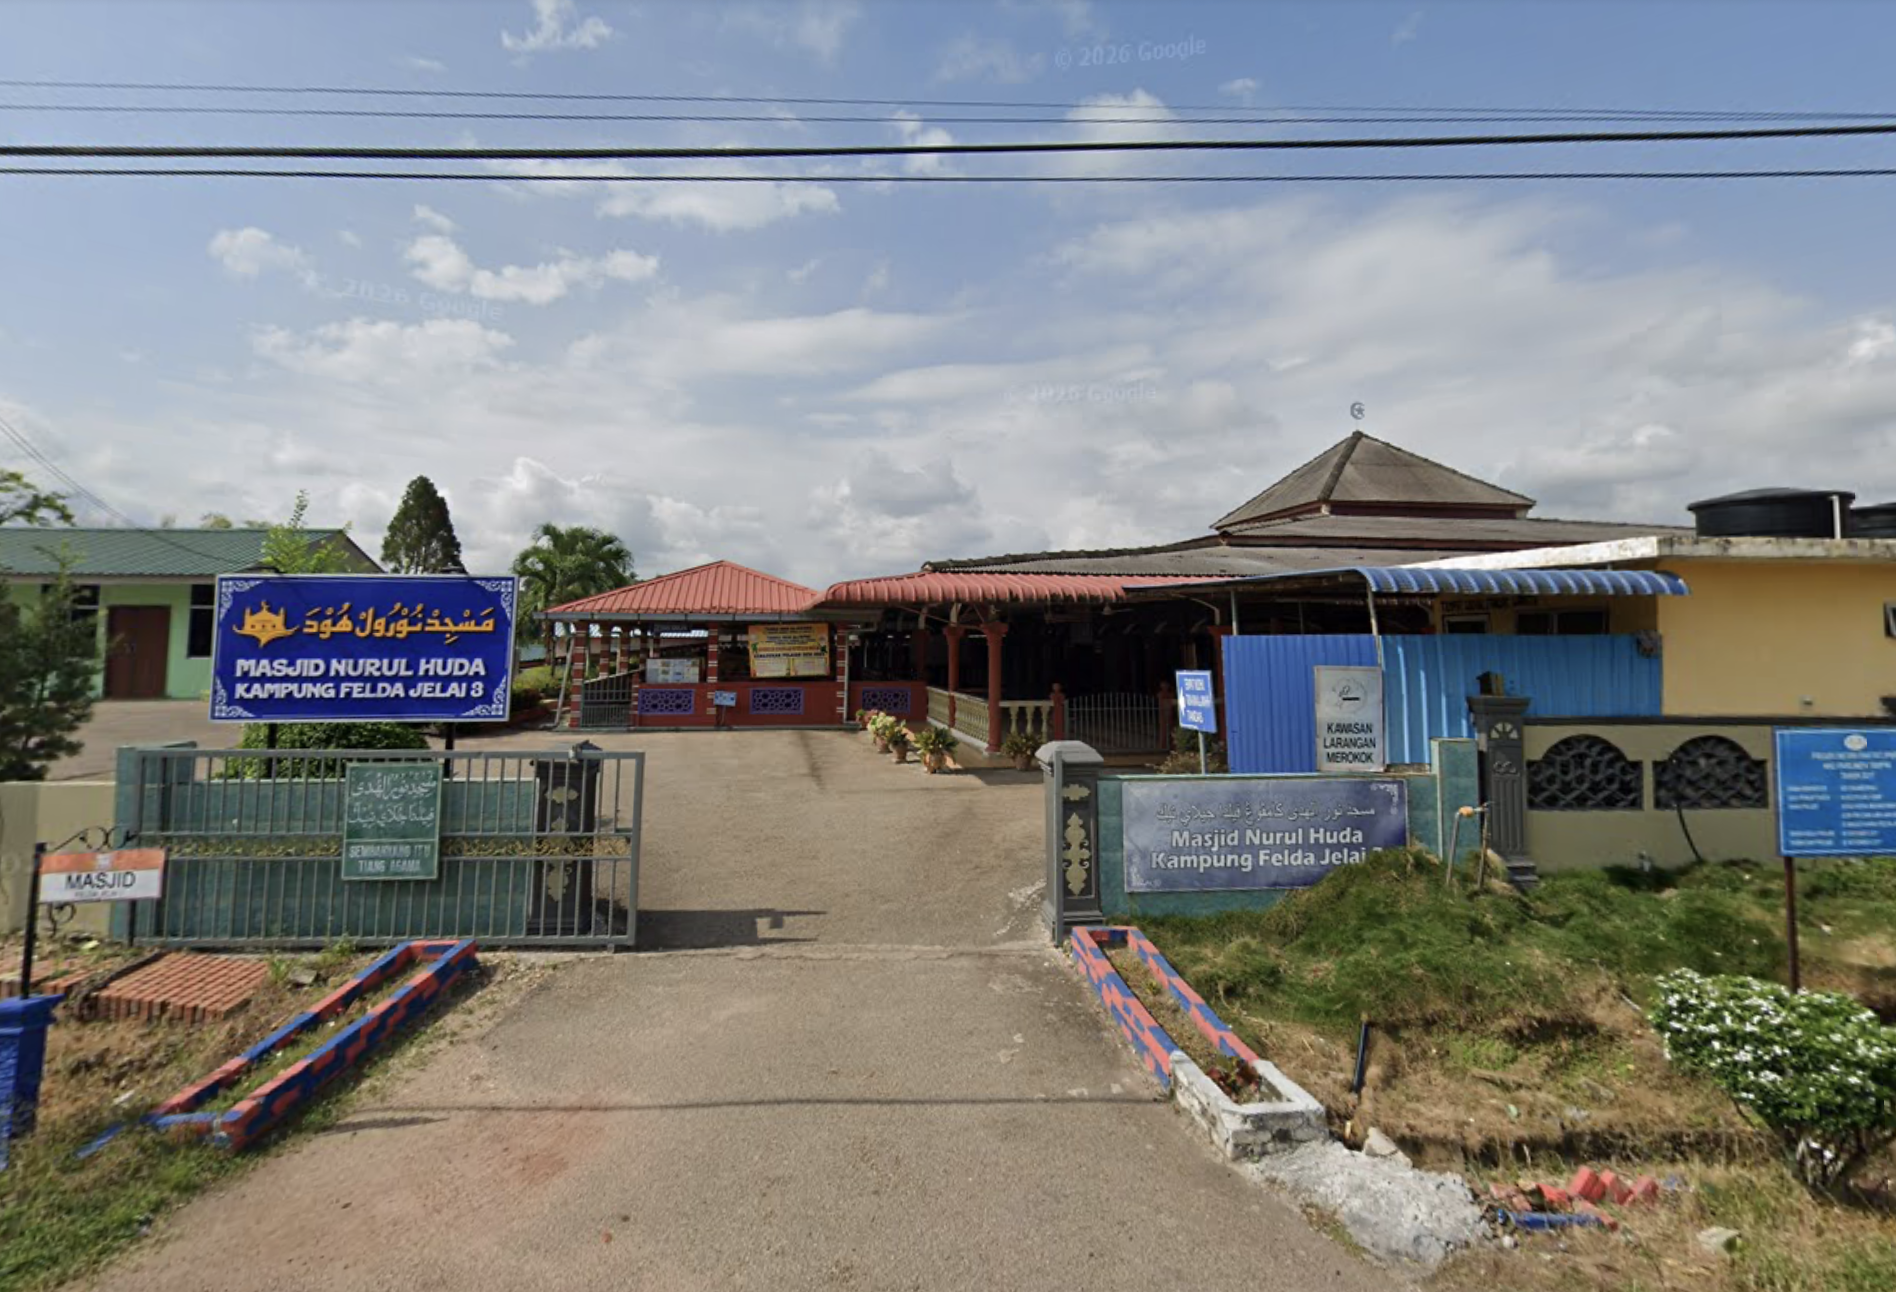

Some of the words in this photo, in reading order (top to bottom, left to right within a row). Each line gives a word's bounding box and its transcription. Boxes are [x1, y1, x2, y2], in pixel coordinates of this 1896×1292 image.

[236, 658, 326, 678] MASJID
[329, 658, 414, 677] NURUL
[418, 657, 486, 676] HUDA
[234, 682, 336, 699] KAMPUNG
[339, 682, 405, 698] FELDA
[408, 681, 467, 698] JELAI
[470, 681, 484, 698] 3
[1326, 722, 1374, 734] KAWASAN
[1323, 737, 1377, 749] LARANGAN
[1326, 751, 1375, 764] MEROKOK
[1171, 830, 1239, 851] Masjid
[1245, 829, 1303, 846] Nurul
[1309, 827, 1363, 844] Huda
[1151, 852, 1253, 873] Kampung
[1258, 849, 1315, 867] Felda
[1319, 848, 1366, 865] Jelai
[65, 871, 137, 890] MASJID
